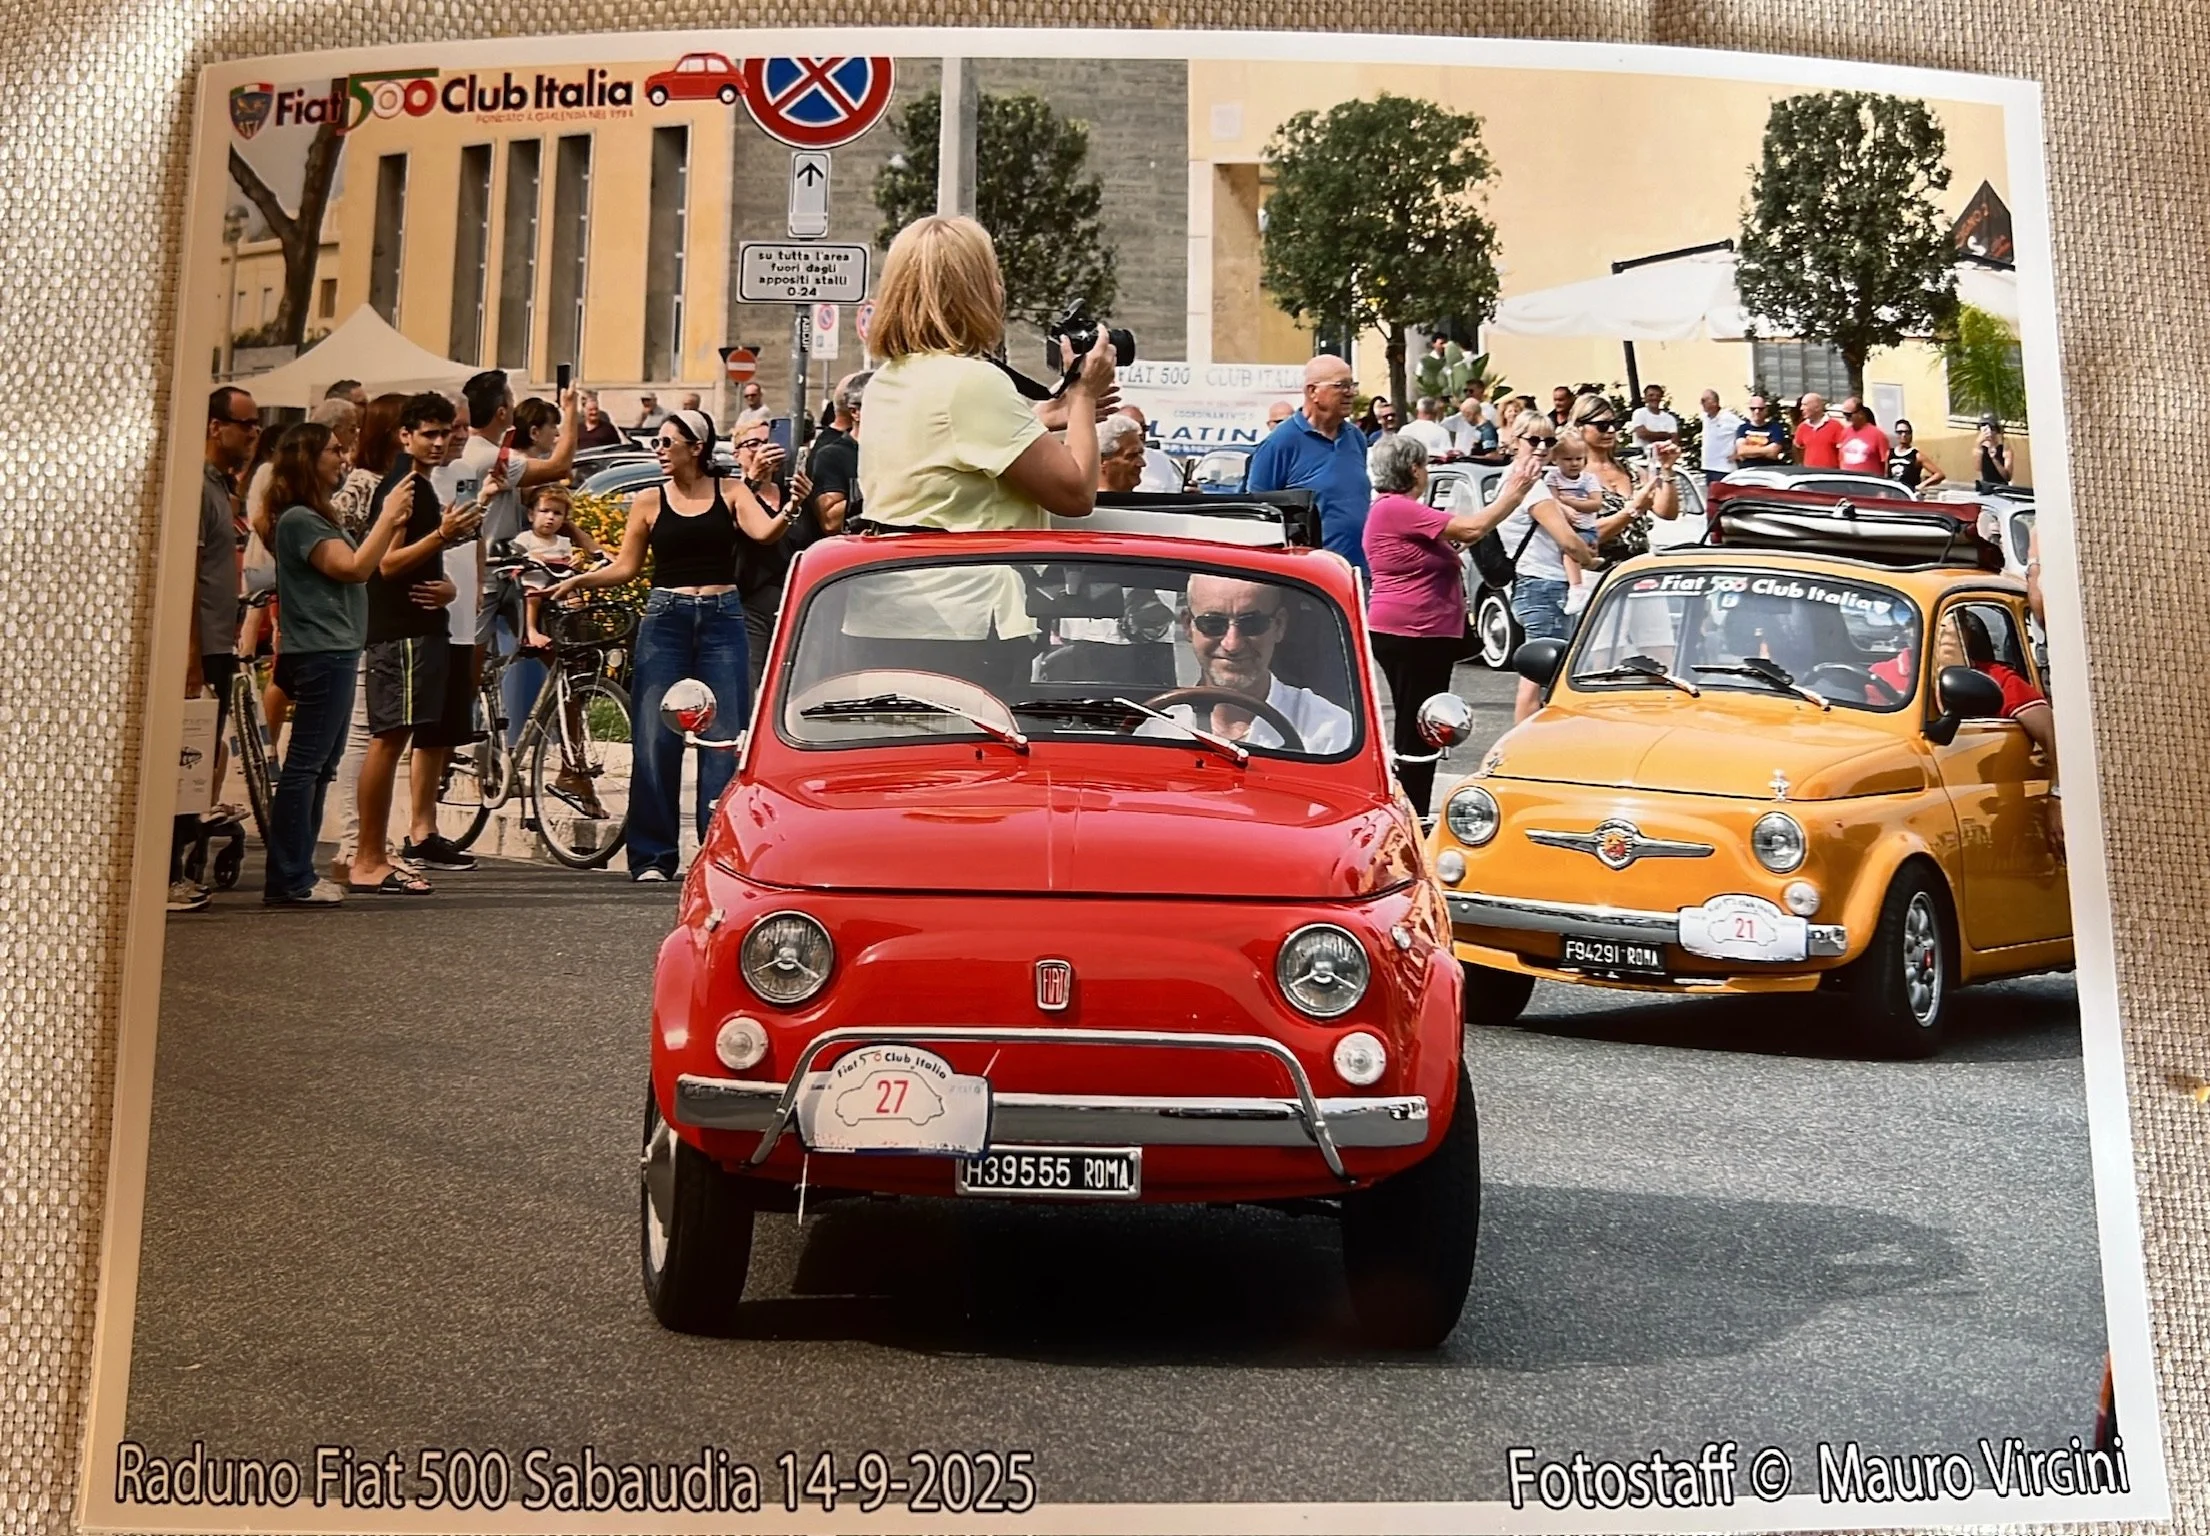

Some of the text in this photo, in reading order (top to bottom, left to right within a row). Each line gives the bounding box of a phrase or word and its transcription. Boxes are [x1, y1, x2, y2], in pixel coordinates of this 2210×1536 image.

[758, 251, 850, 261] su tutta l'area
[771, 263, 837, 274] fuori dagli
[758, 275, 847, 285] appositi stalli
[1660, 575, 1872, 612] Fiat 500 Club Italia
[1734, 917, 1755, 939] 21
[1565, 940, 1659, 966] F94291 ROMA
[1042, 967, 1066, 1003] FIAT
[837, 1060, 858, 1077] Fiat
[884, 1052, 911, 1064] Club
[915, 1056, 947, 1079] Italia
[875, 1079, 909, 1114] 27
[967, 1155, 1130, 1189] H39555 ROMA
